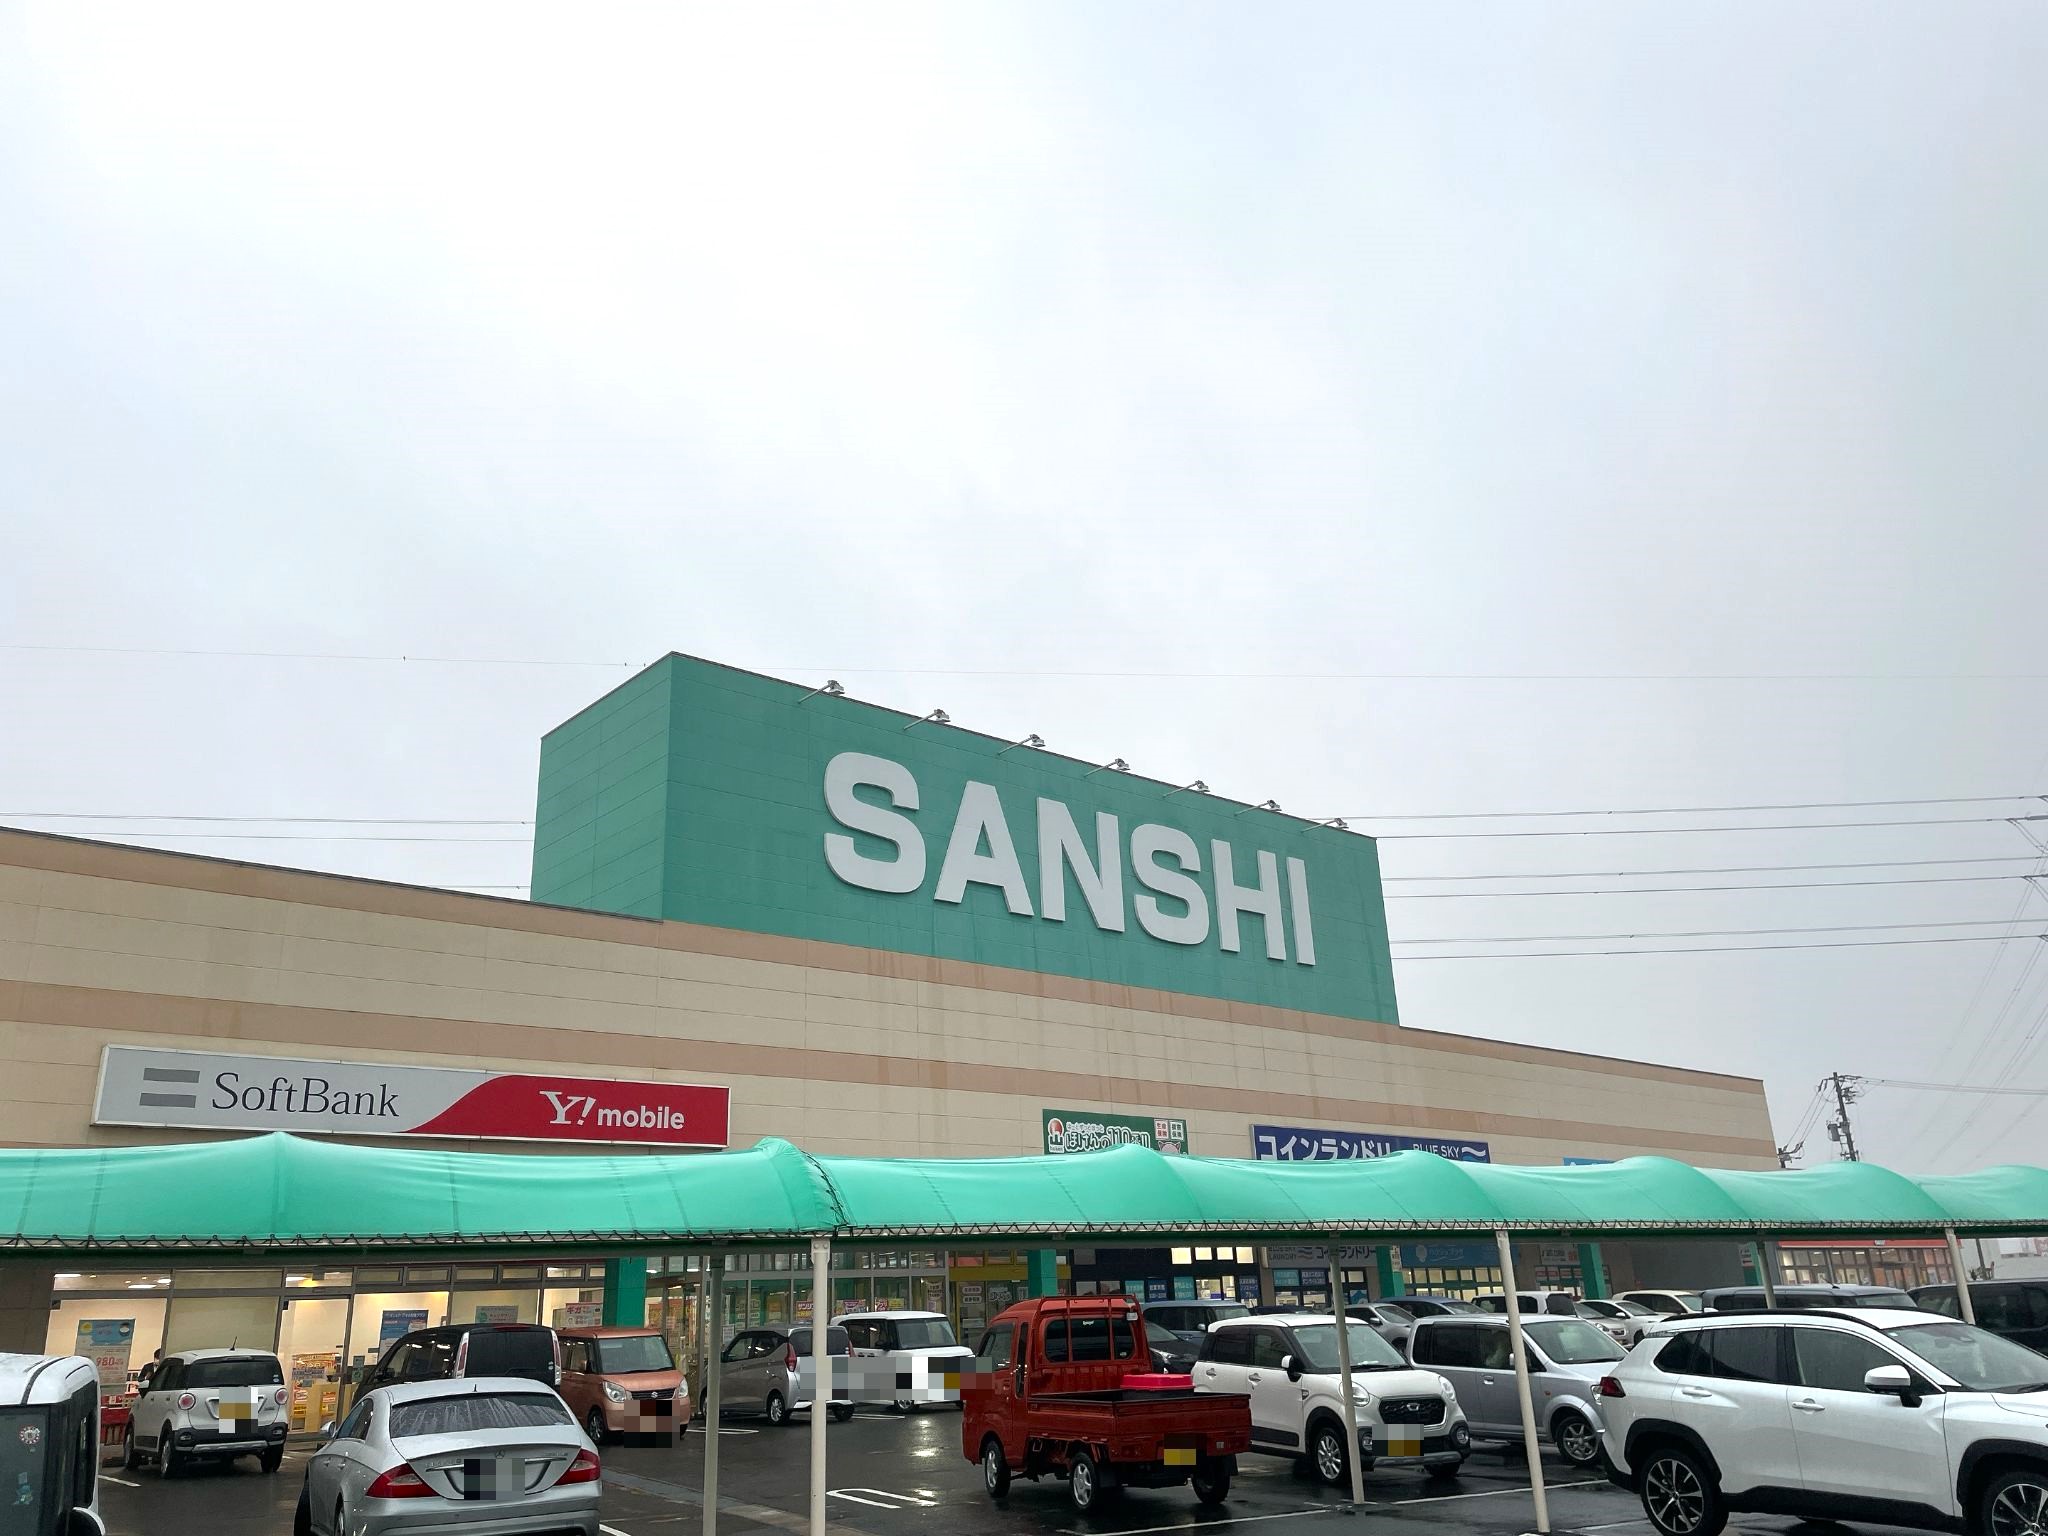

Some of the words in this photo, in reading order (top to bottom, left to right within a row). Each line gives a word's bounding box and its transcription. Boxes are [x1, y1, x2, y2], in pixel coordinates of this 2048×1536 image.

[823, 751, 1316, 966] SANSHI
[211, 1072, 400, 1118] SoftBank
[1258, 1135, 1391, 1160] コインランドリ
[1441, 1145, 1459, 1158] SKY
[1315, 1245, 1377, 1260] コイランドリー
